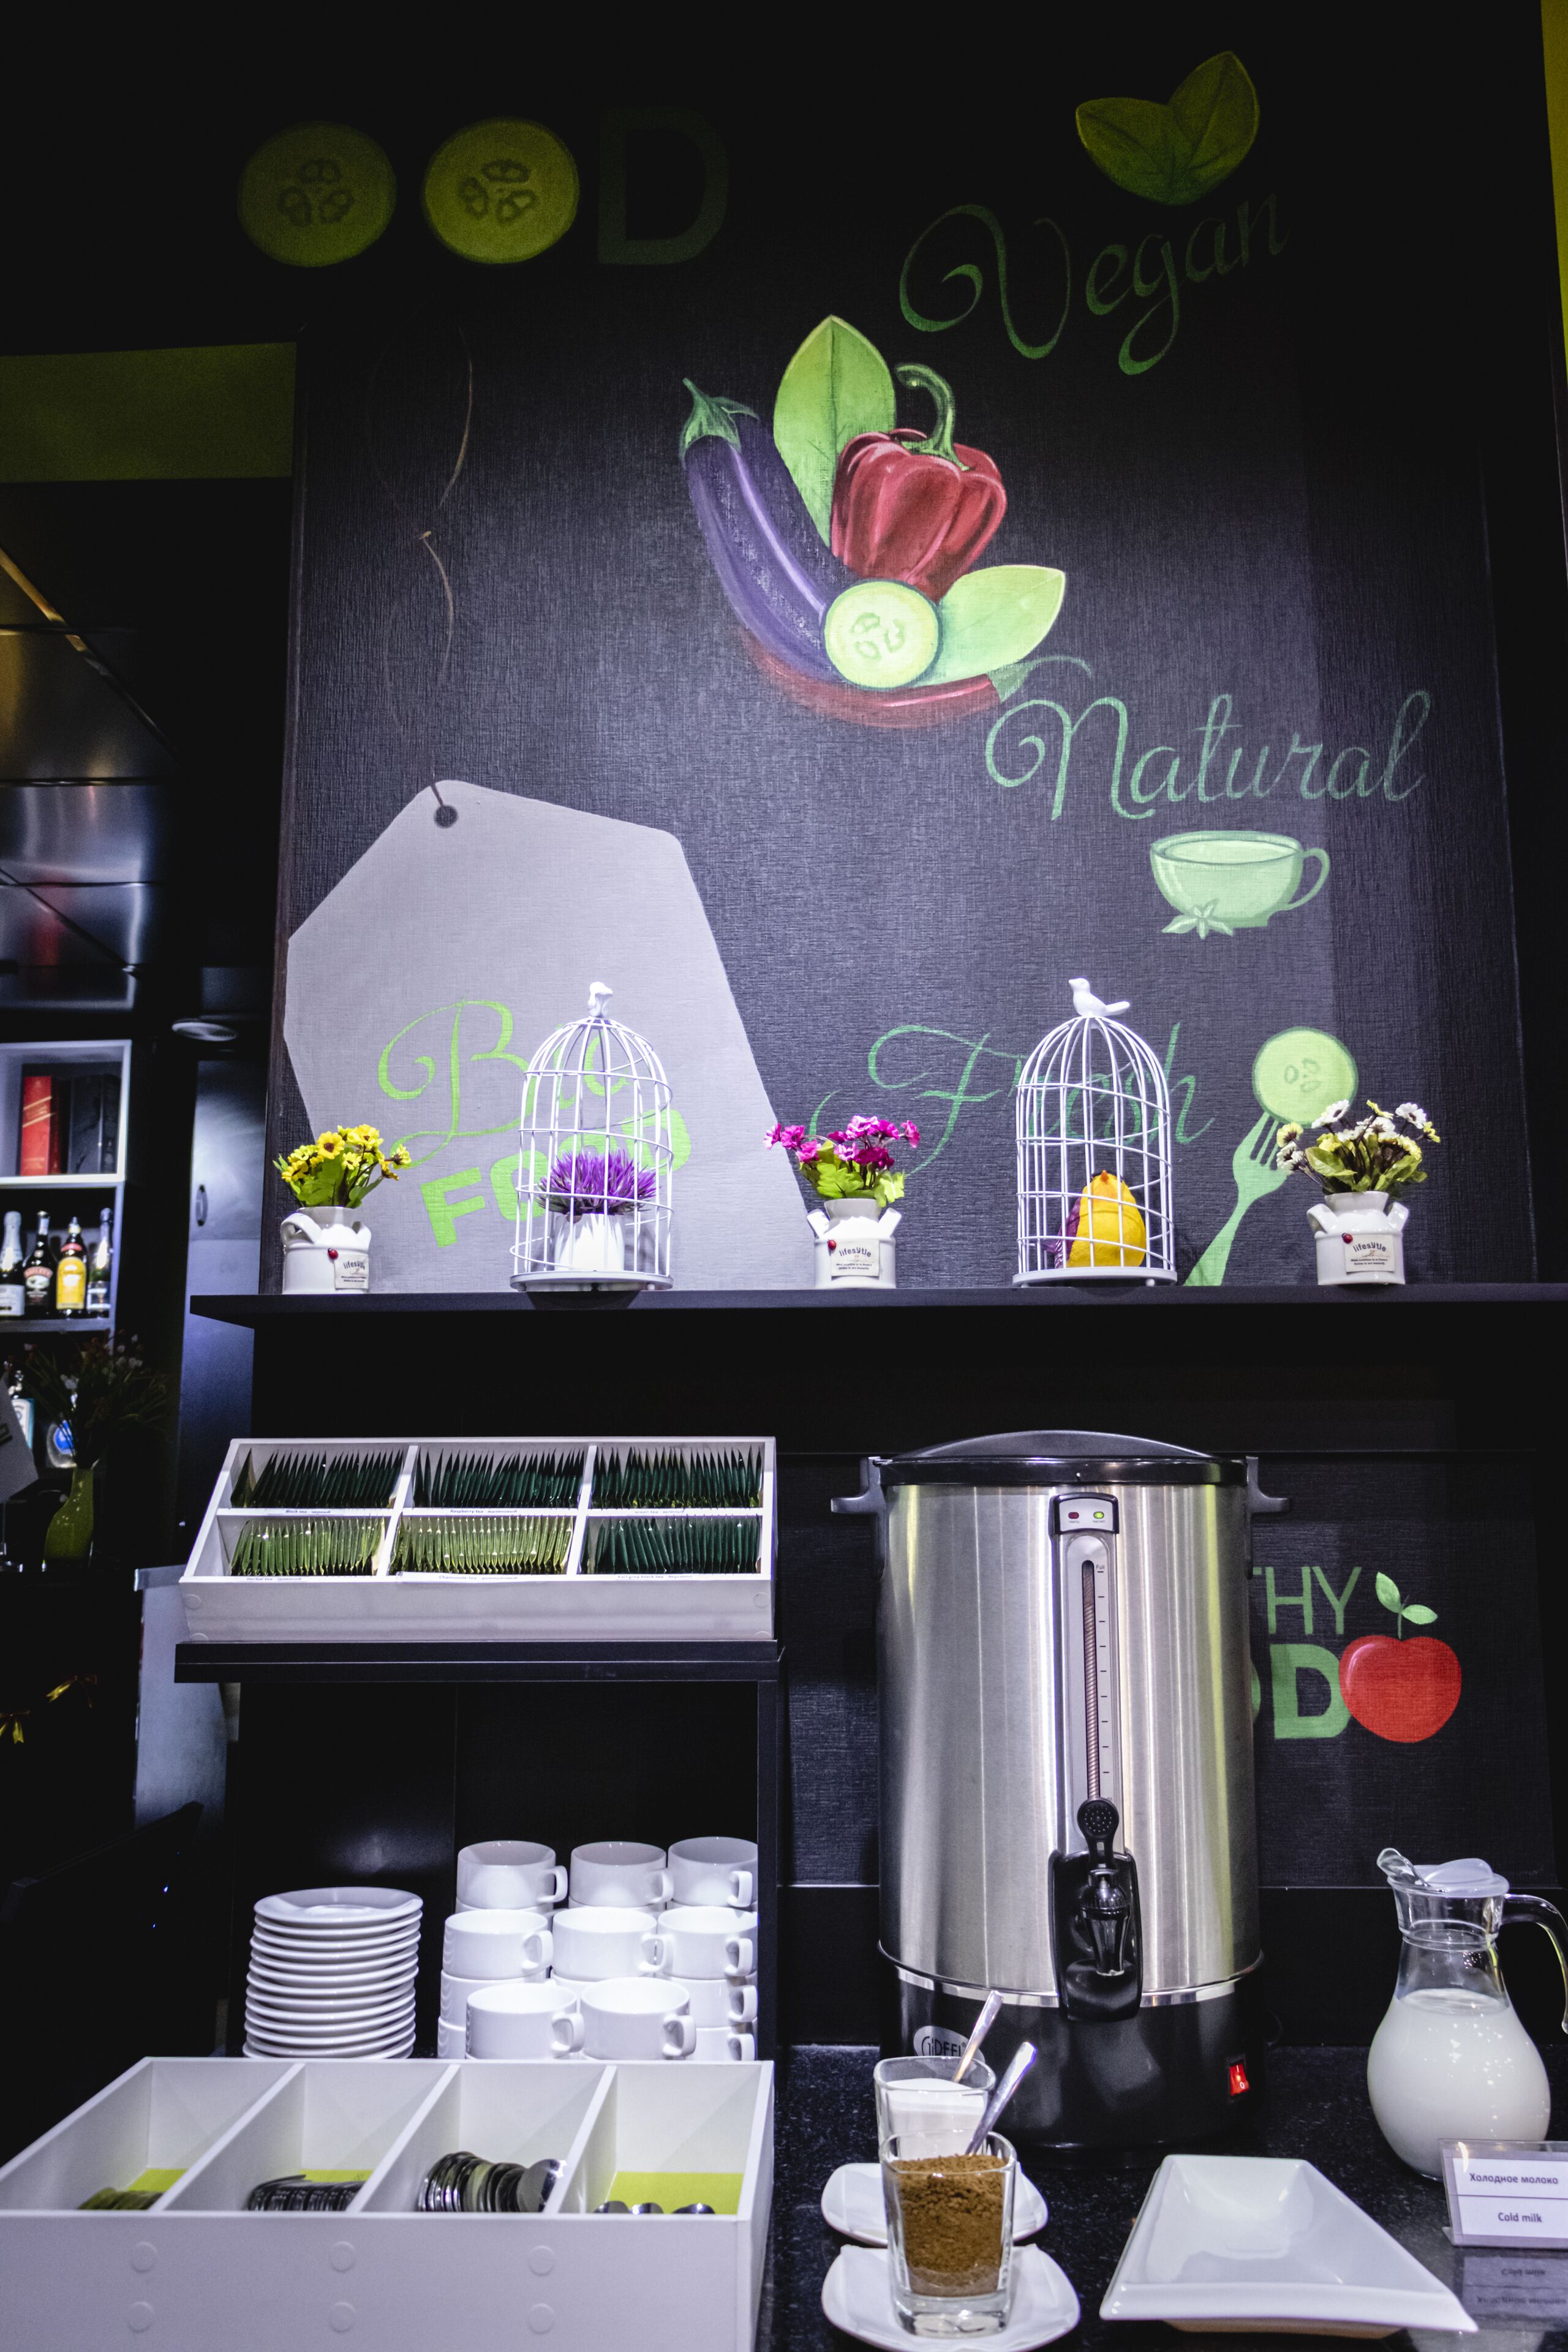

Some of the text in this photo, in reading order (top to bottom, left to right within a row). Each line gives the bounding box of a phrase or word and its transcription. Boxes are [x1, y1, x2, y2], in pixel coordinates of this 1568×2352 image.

[899, 194, 1292, 376] Vegan
[986, 690, 1431, 821] Natural
[807, 1022, 1215, 1178] Fresh
[839, 1247, 872, 1257] lifesytle
[1353, 1242, 1387, 1252] lifesytle
[1253, 1566, 1362, 1635] HY
[1251, 1643, 1351, 1739] D
[1470, 2173, 1518, 2184] Холодное
[1498, 2212, 1542, 2222] Cold milk
